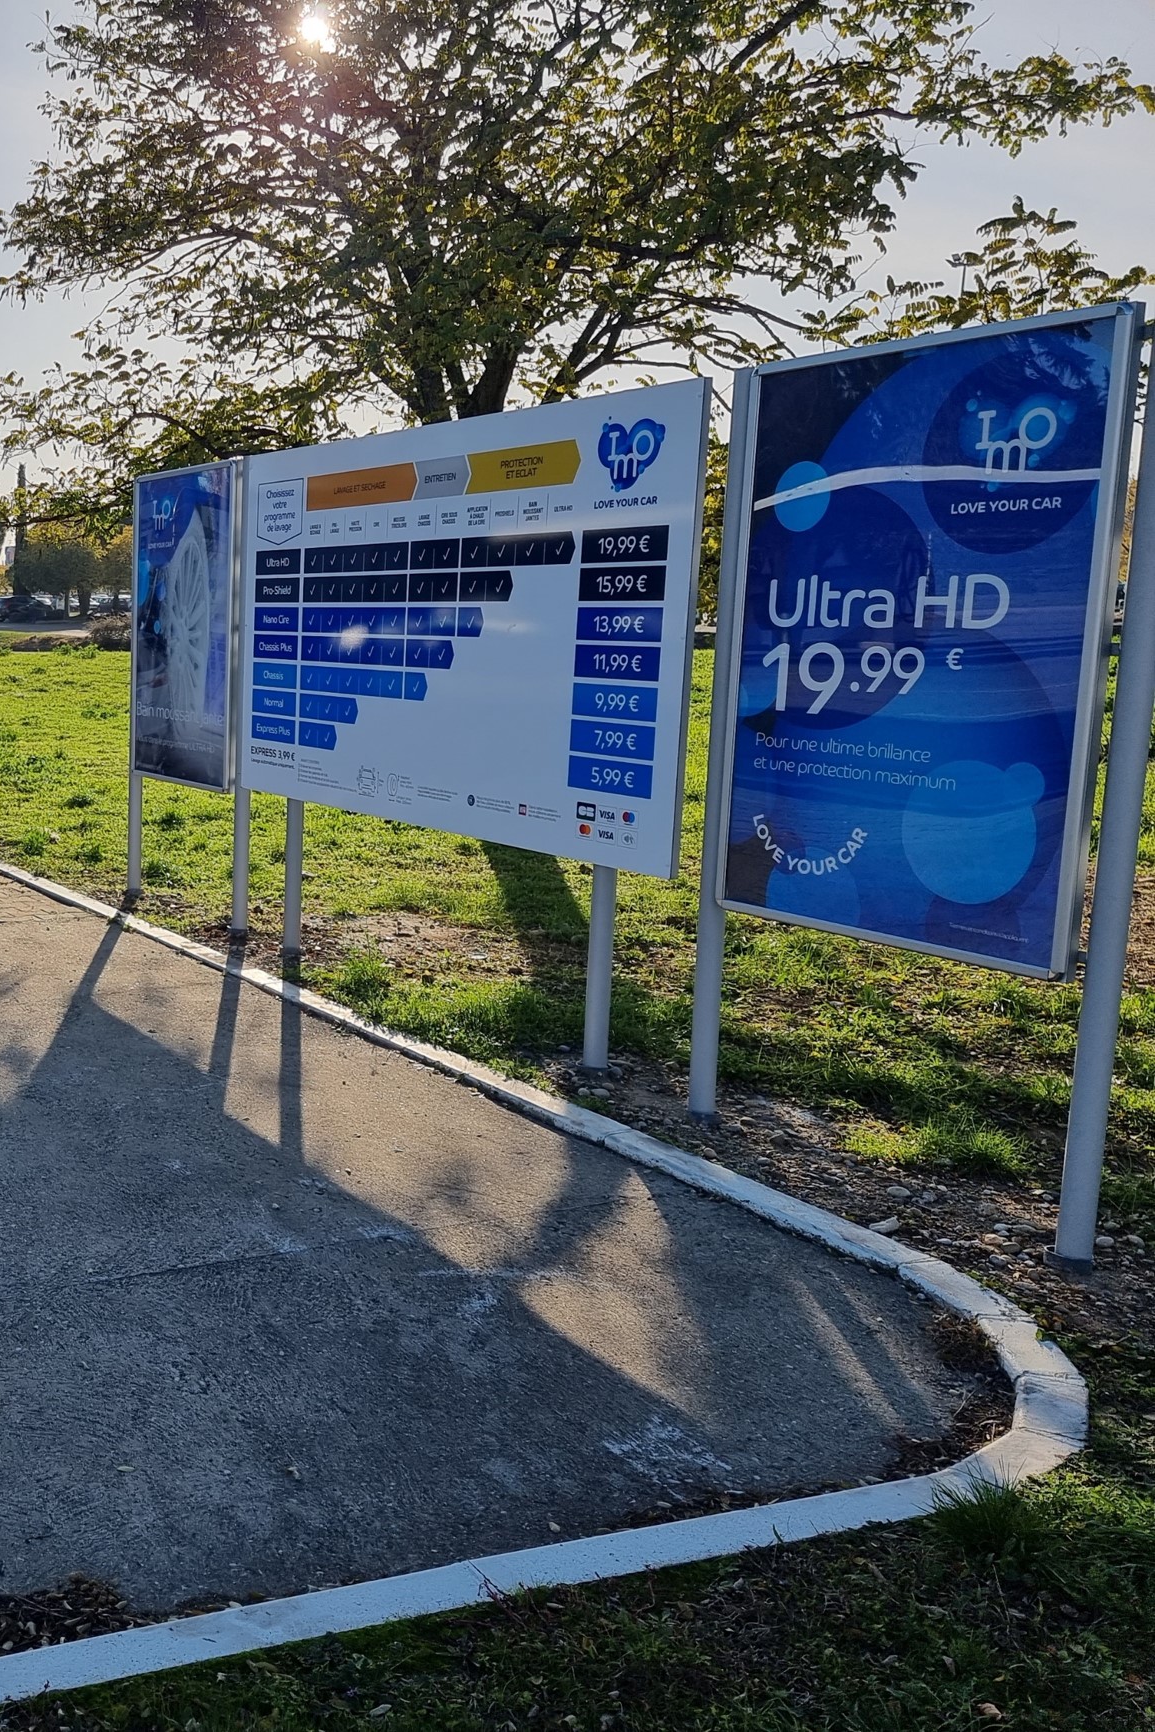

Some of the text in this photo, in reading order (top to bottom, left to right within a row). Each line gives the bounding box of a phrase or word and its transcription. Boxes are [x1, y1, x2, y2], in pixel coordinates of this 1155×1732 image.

[500, 456, 544, 469] PROTECTION
[424, 472, 457, 484] ENTRETIEN
[506, 467, 538, 479] ET ECLAT
[266, 488, 295, 499] Choisissez
[333, 480, 386, 495] LAVAGE ET SECHAGE
[272, 501, 287, 510] votre
[594, 496, 658, 509] LOVE YOUR CAR
[950, 496, 1062, 515] LOVE YOUR CAR
[264, 511, 295, 524] programme
[266, 523, 292, 533] de lavage
[598, 535, 651, 557] 19,99 €
[266, 557, 290, 568] Ultra HD
[263, 585, 292, 596] Pro-Shield
[596, 575, 647, 596] 15,99 €
[768, 573, 1010, 630] Ultra HD
[263, 614, 290, 624] Nano Cire
[594, 616, 645, 636] 13,99 €
[259, 641, 292, 653] Chassis Plus
[593, 654, 642, 673] 11,99 €
[263, 670, 284, 680] Chassis
[762, 642, 964, 715] 19.99 €
[136, 701, 154, 717] Bain
[263, 698, 284, 708] Normal
[595, 693, 640, 713] 9,99 €
[256, 723, 291, 736] Express Plus
[594, 730, 637, 751] 7,99 €
[251, 745, 296, 762] EXPRESS 3,99 €
[755, 732, 931, 763] Pour une ultime brillance
[590, 767, 635, 788] 5,99 €
[753, 756, 956, 791] et une protection maximum
[578, 805, 595, 818] CB
[599, 809, 615, 821] VISA
[598, 829, 614, 841] VISA
[752, 813, 868, 876] LOVE YOUR CAR
